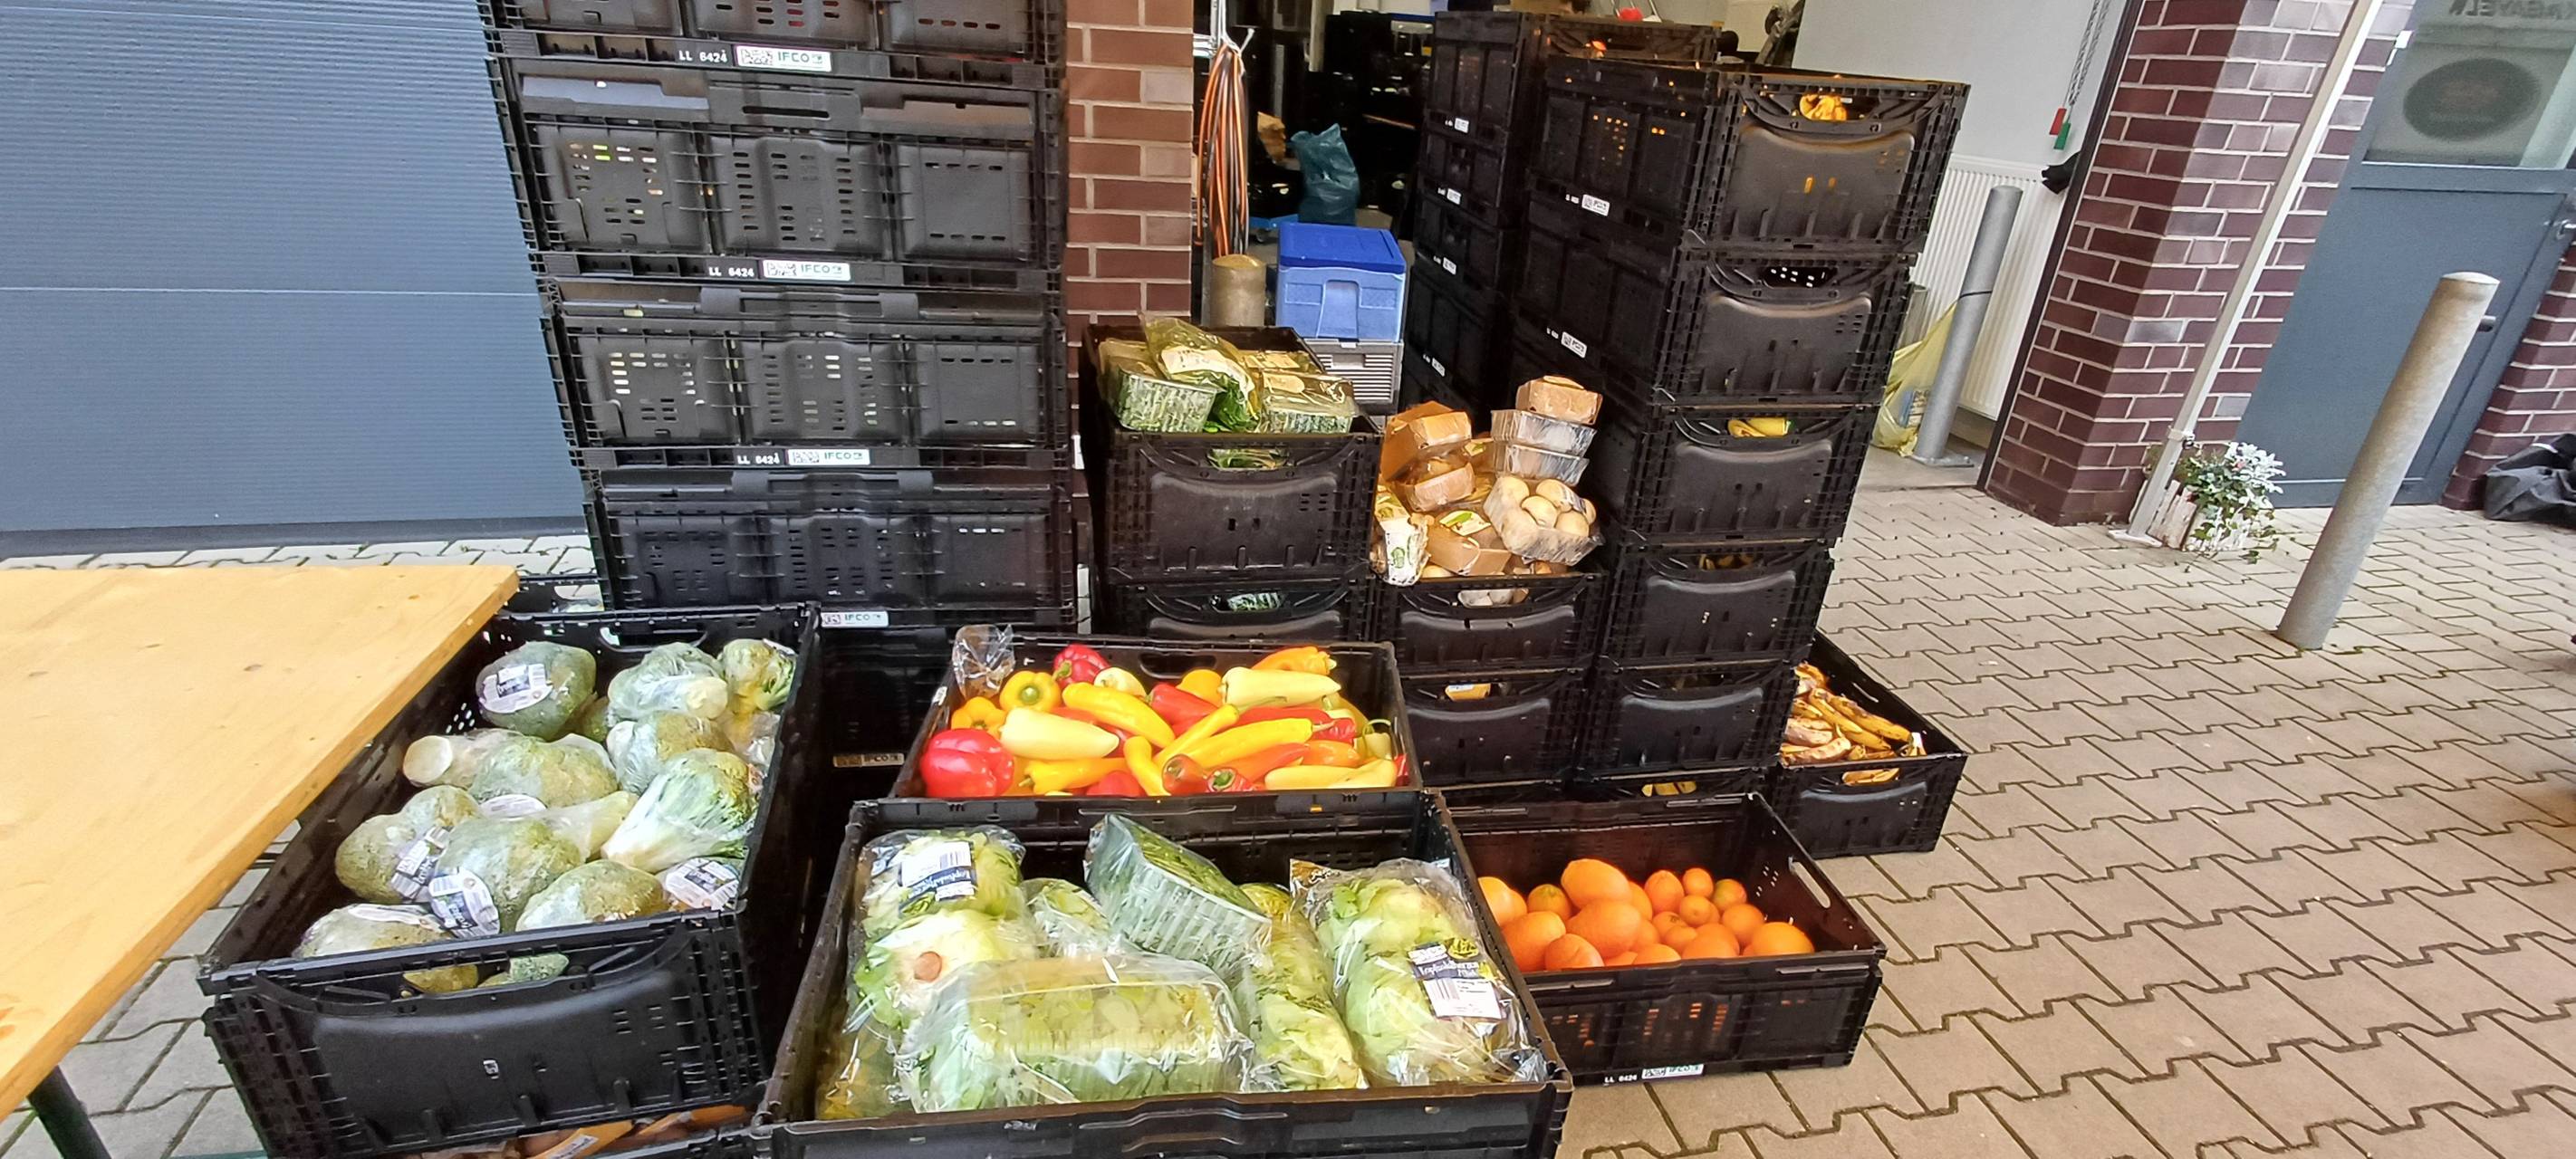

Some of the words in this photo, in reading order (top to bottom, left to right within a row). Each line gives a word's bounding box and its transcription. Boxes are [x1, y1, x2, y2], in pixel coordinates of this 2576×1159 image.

[678, 51, 693, 62] LL
[778, 52, 810, 63] IFCO
[708, 267, 722, 277] LL
[801, 263, 831, 274] IFCO
[736, 455, 751, 465] LL
[824, 452, 852, 460] IFCO
[844, 613, 870, 621] IFCO
